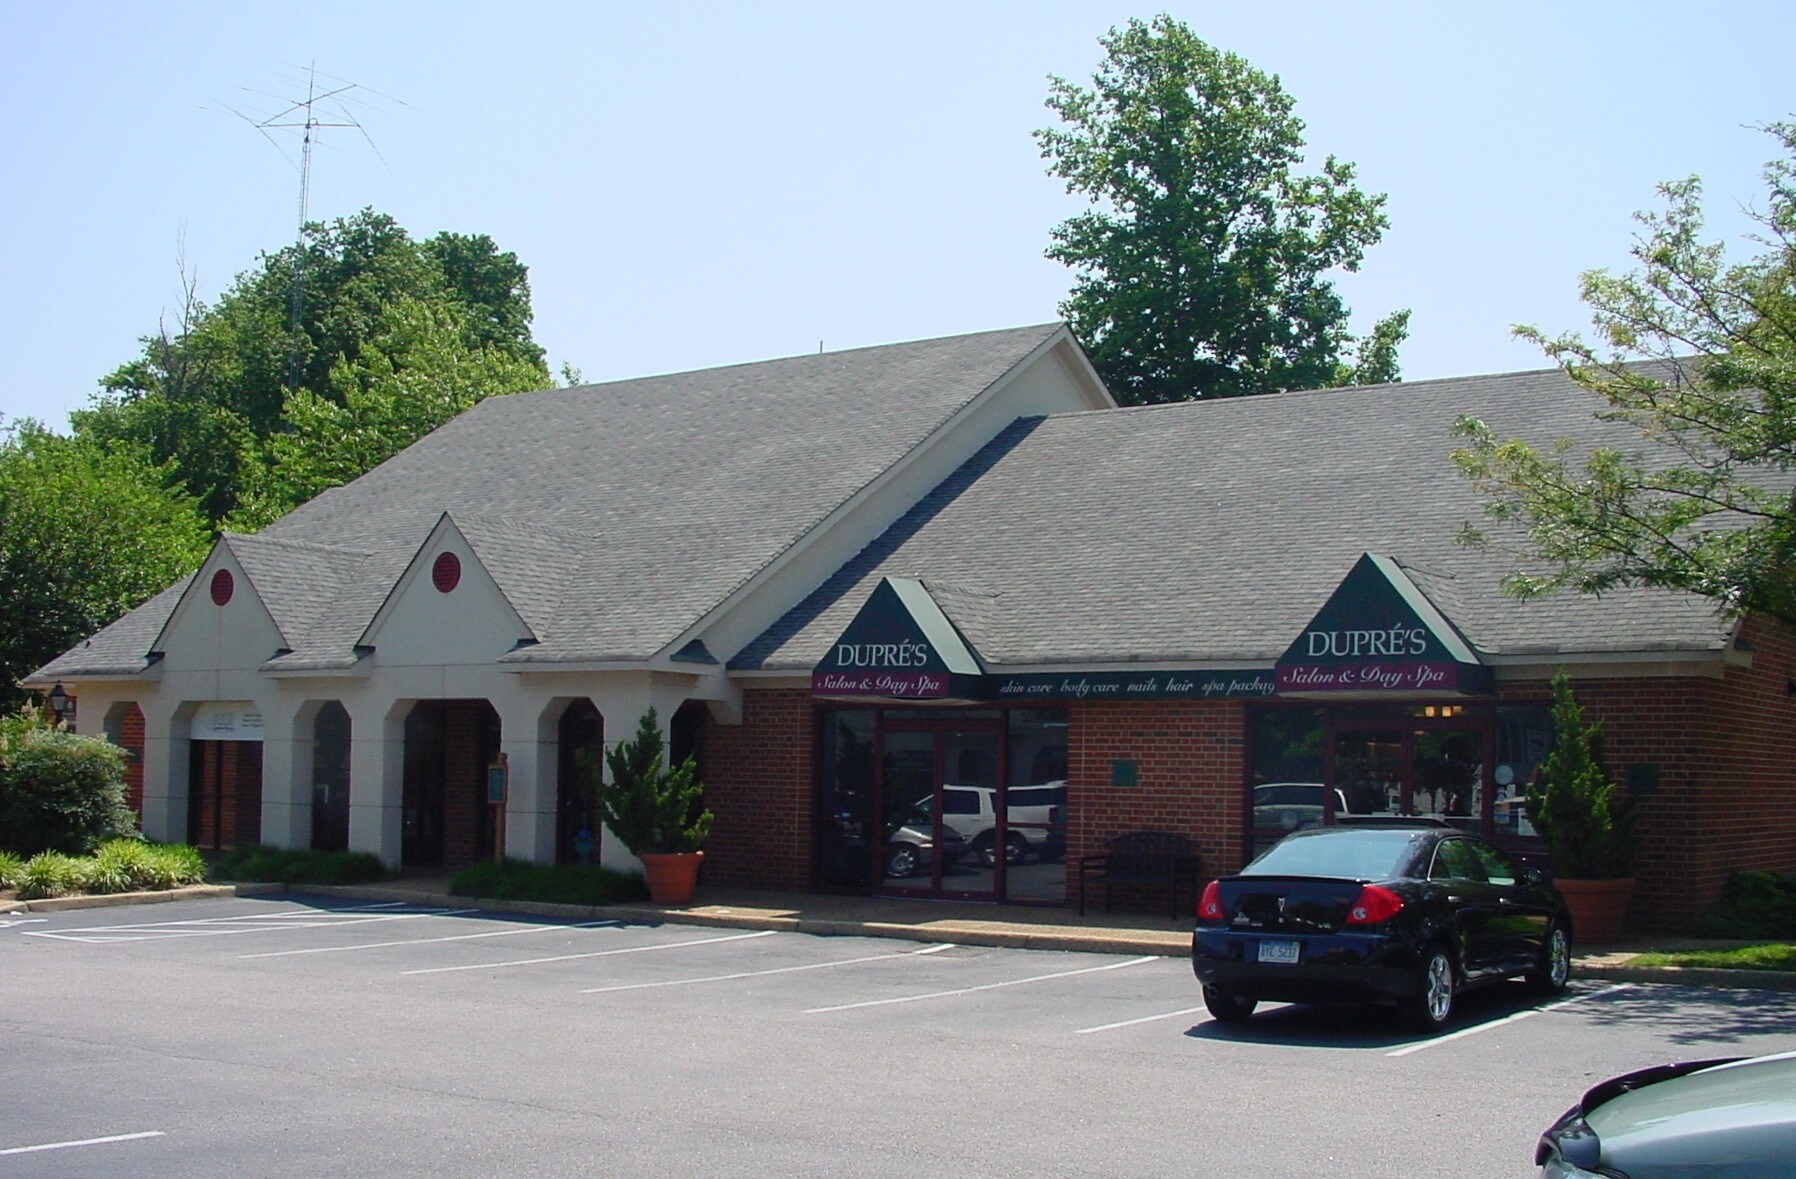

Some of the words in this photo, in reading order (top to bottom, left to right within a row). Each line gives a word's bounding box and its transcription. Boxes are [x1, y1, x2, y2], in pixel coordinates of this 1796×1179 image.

[1307, 622, 1427, 657] DUPRÉ'S
[837, 638, 927, 667] DUPRÉ'S
[817, 674, 857, 690] Salon
[859, 677, 872, 690] &
[875, 675, 909, 695] Day
[911, 674, 940, 695] Spa
[1000, 680, 1024, 693] skin
[1027, 684, 1053, 693] care
[1060, 678, 1090, 697] body
[1092, 683, 1120, 692] care
[1126, 677, 1158, 692] nails
[1165, 677, 1194, 692] hair
[1201, 679, 1225, 696] spa
[1283, 667, 1334, 684] Salon
[1338, 669, 1355, 683] &
[1359, 666, 1403, 688] Day
[1407, 664, 1446, 688] Spa
